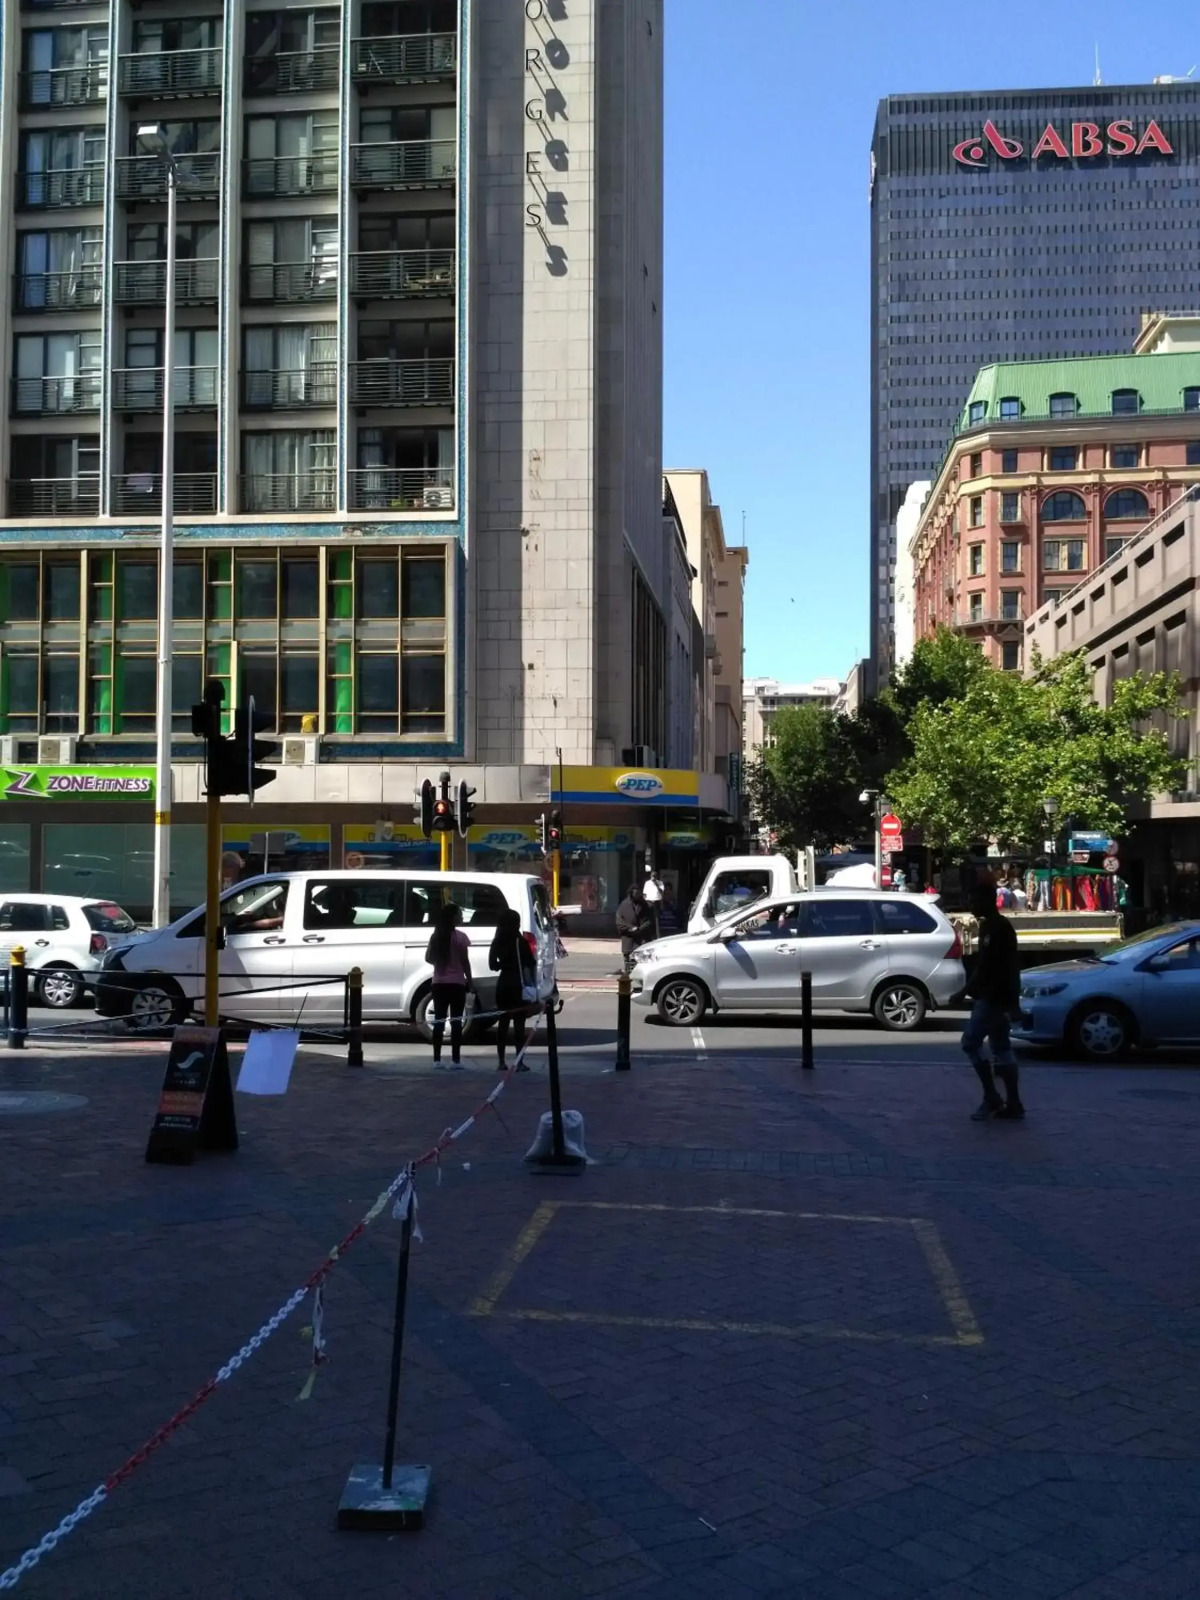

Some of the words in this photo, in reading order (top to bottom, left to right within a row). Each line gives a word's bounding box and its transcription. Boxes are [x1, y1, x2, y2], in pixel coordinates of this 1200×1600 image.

[1031, 119, 1174, 159] ABSA
[622, 778, 658, 791] PEP
[484, 833, 523, 845] PEP
